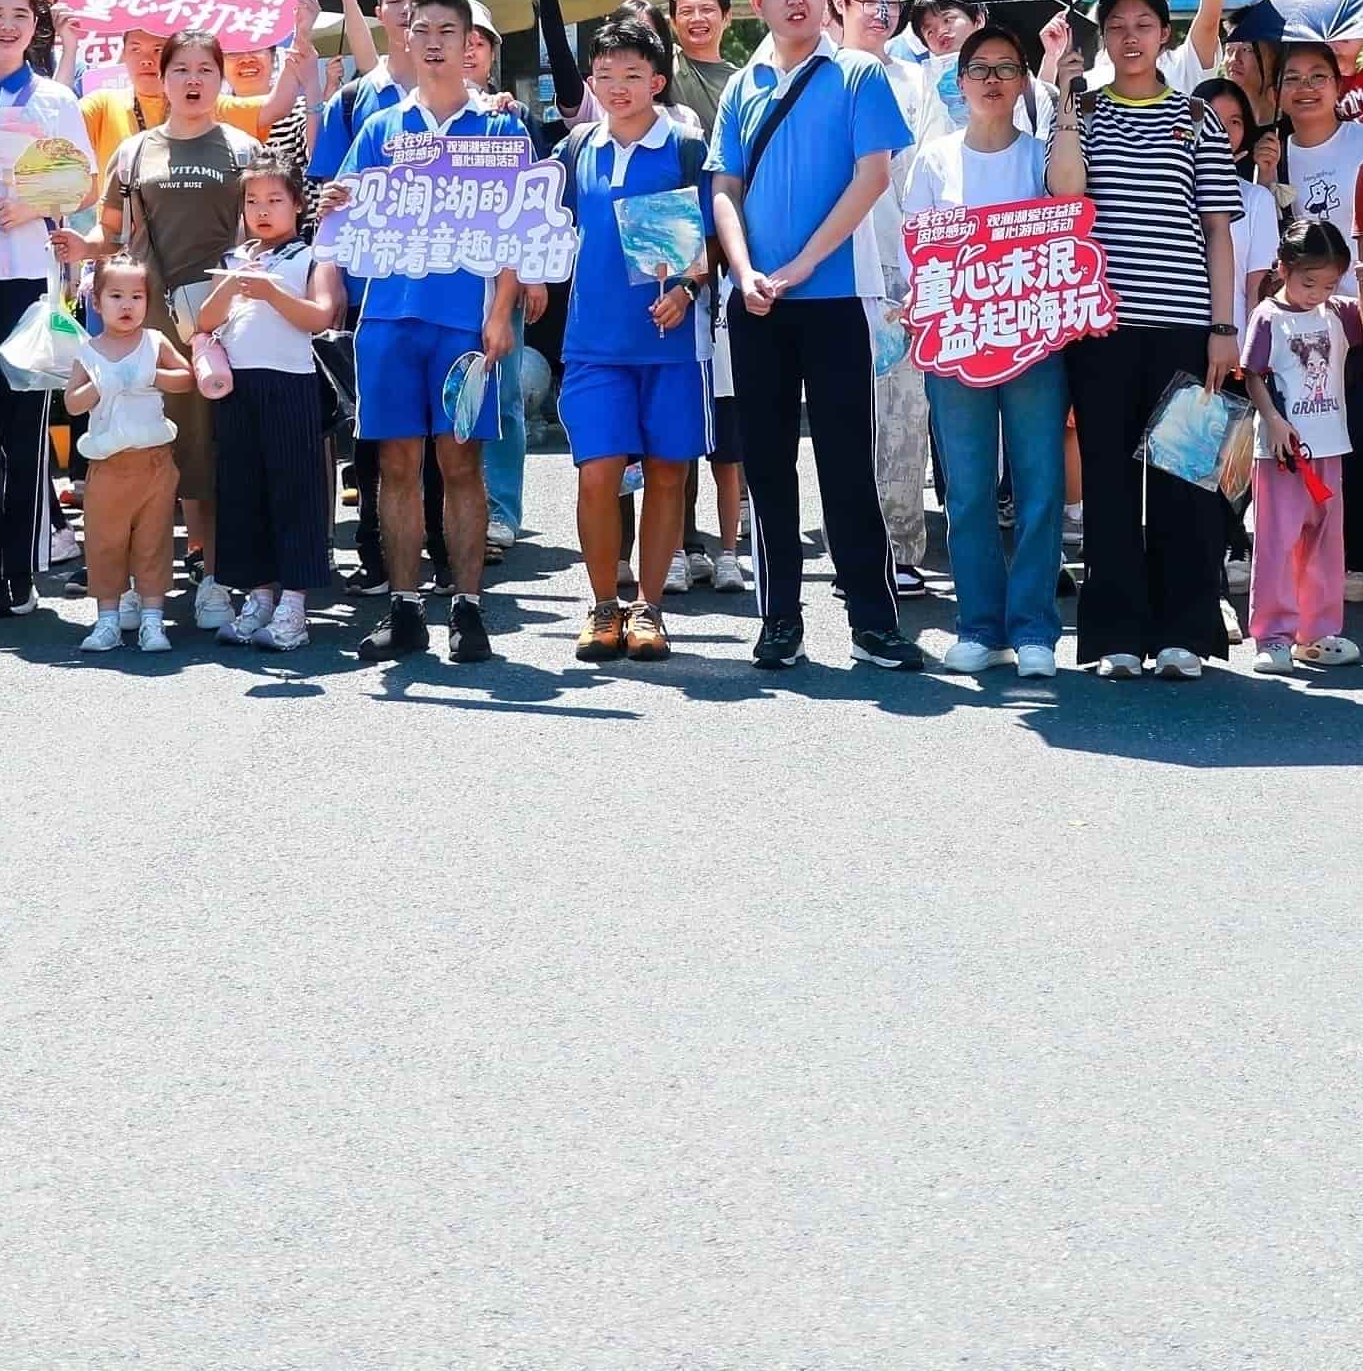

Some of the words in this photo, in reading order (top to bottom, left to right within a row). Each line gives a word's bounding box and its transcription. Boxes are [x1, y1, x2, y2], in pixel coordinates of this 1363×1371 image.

[171, 166, 224, 184] VITAMIN
[343, 166, 568, 228] 观澜湖的风
[917, 208, 966, 227] 爱在9月
[335, 222, 575, 274] 都带着童趣的甜
[914, 240, 1081, 320] 童心未泯
[938, 284, 1114, 364] 益起嗨玩
